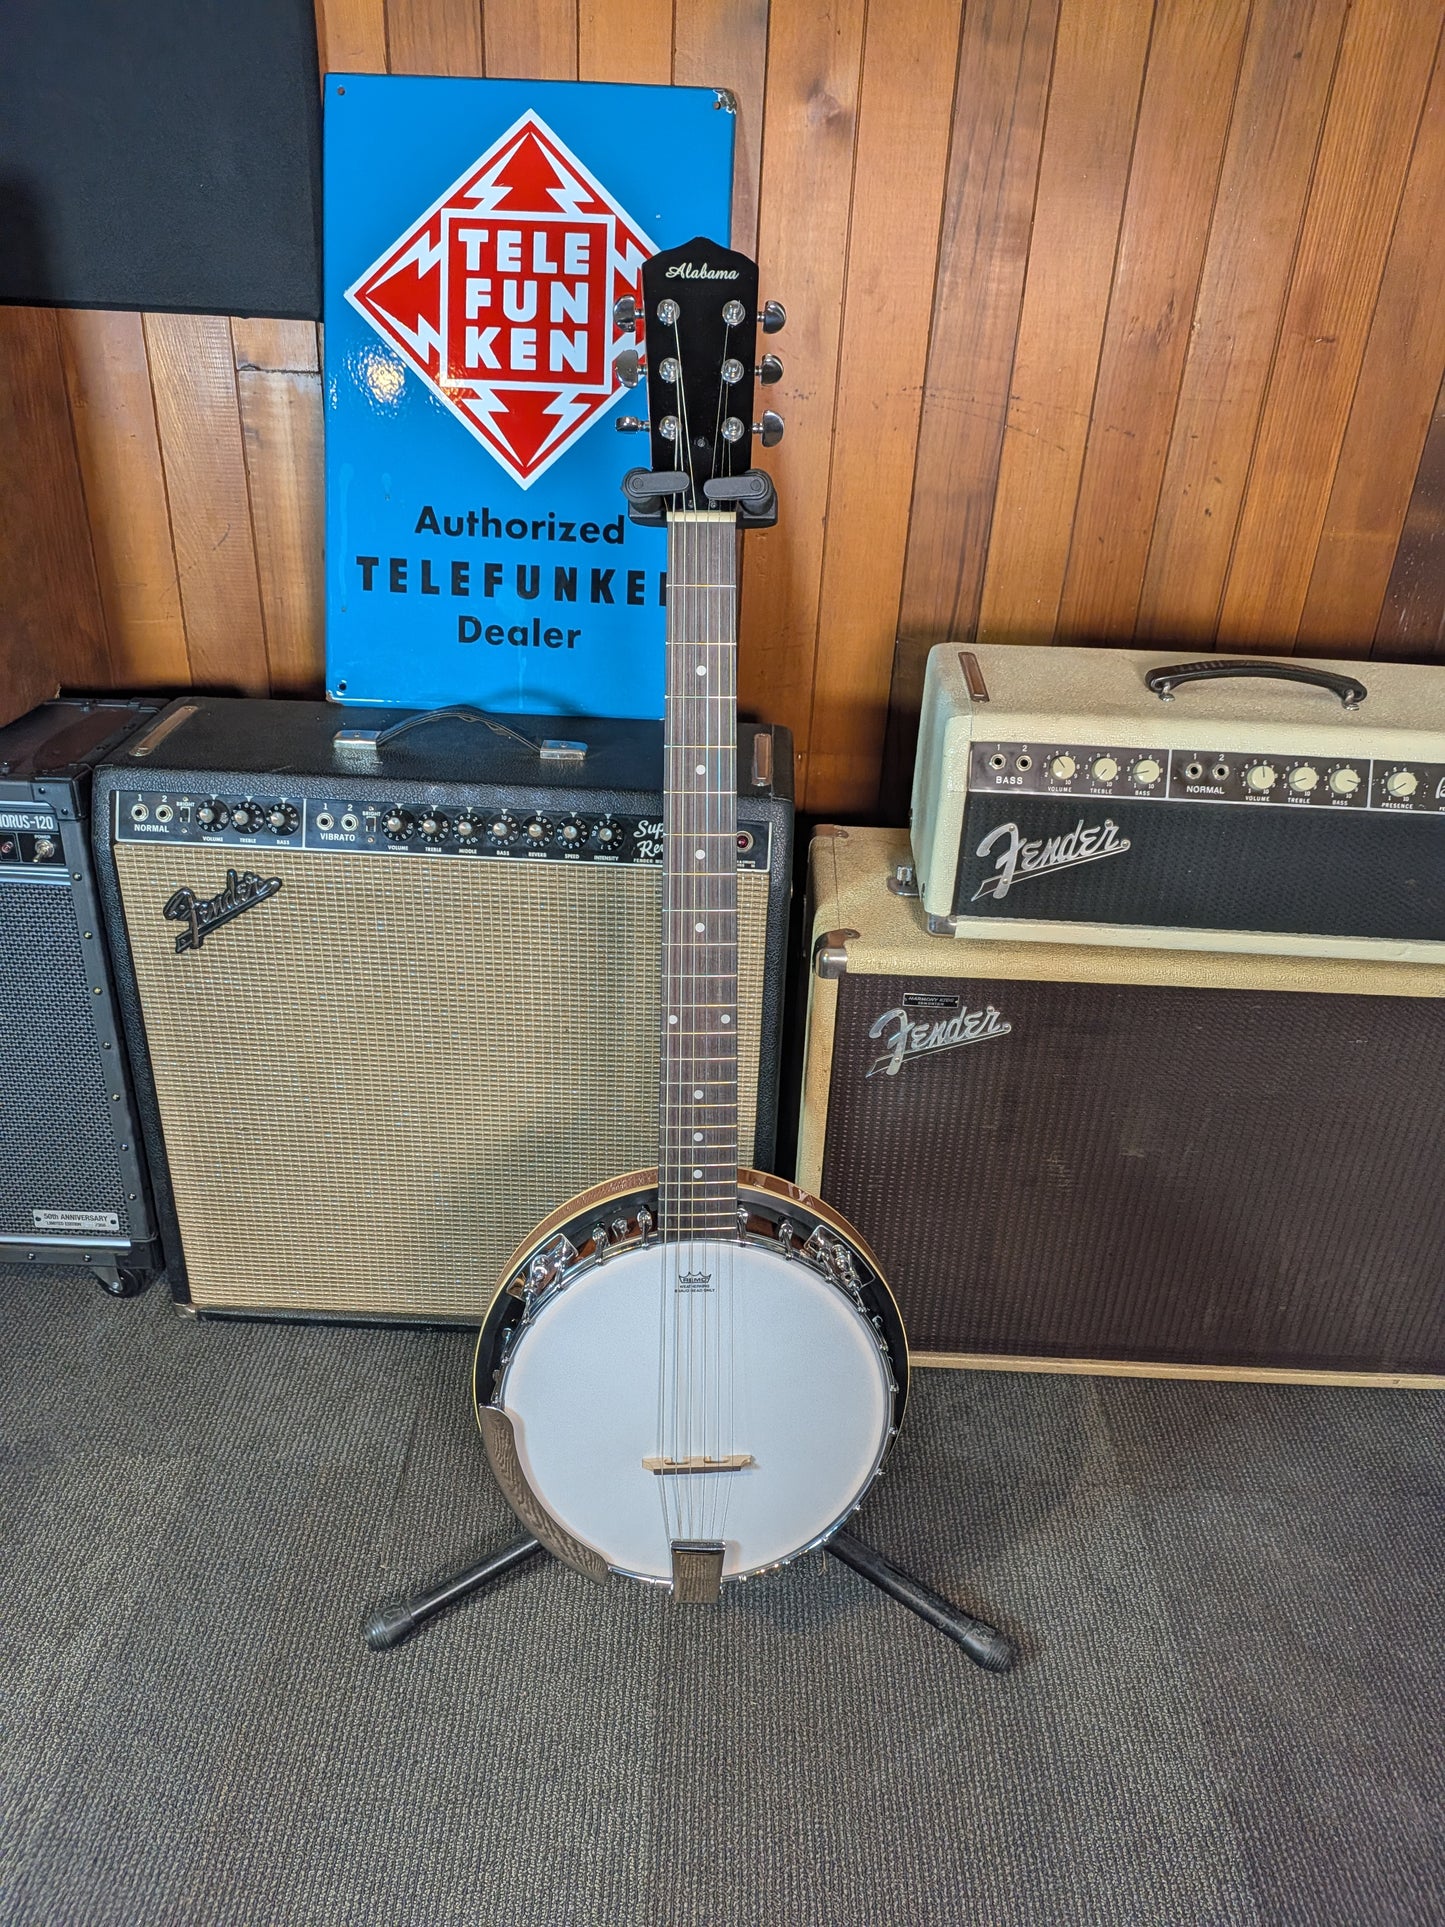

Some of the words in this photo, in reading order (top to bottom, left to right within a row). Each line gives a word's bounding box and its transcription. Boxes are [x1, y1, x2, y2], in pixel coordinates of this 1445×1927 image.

[458, 228, 590, 275] TELE
[665, 262, 739, 280] Alabama
[466, 278, 589, 324] FUN
[465, 326, 588, 373] KEN
[415, 505, 625, 544] Authorized
[458, 615, 581, 648] Dealer
[996, 776, 1023, 784] BASS
[1186, 785, 1225, 794] NORMAL
[134, 824, 169, 833] NORMAL
[320, 833, 355, 842] VIBRATO
[633, 820, 663, 840] Sup
[971, 818, 1131, 902] Fender
[162, 868, 283, 954] Fender
[866, 1006, 1012, 1078] Fender
